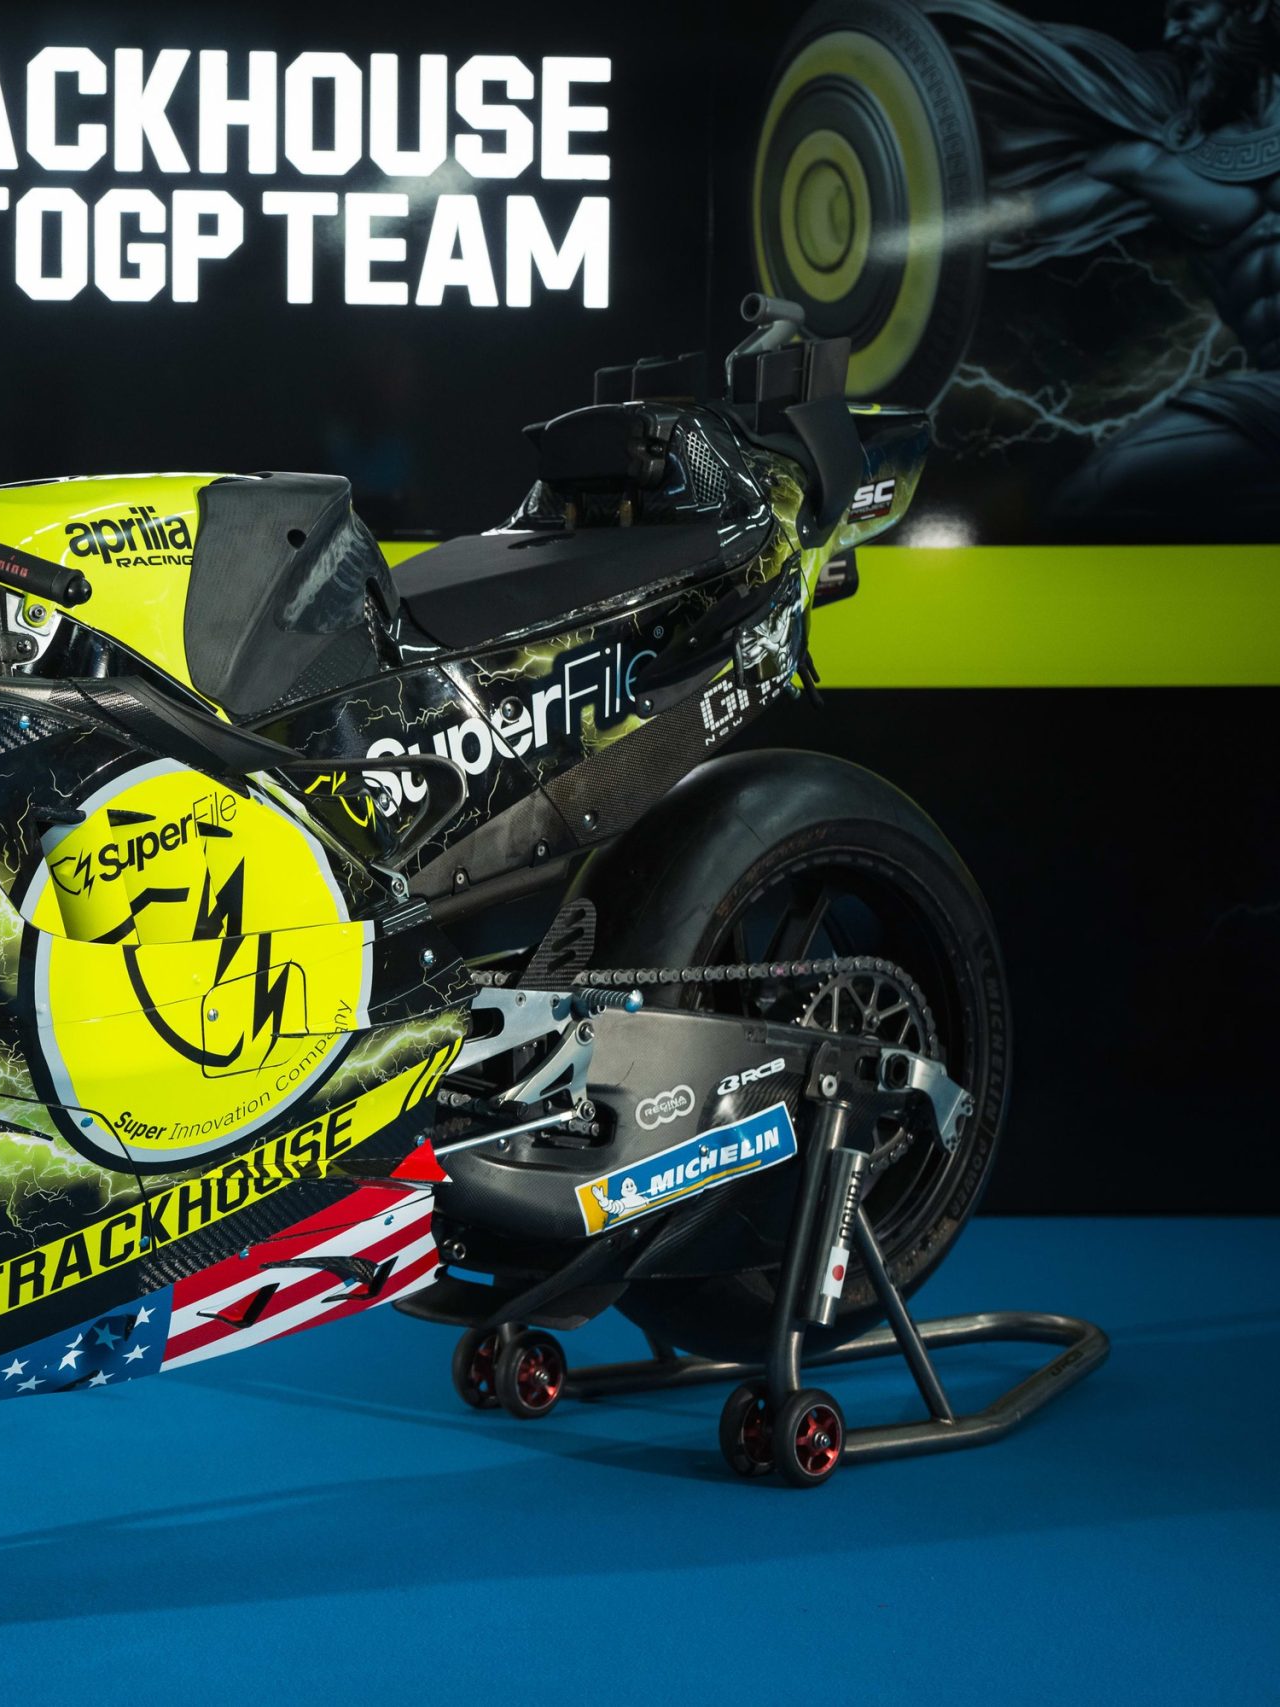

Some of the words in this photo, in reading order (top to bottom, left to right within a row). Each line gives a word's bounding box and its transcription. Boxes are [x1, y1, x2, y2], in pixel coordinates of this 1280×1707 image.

[262, 191, 610, 308] TEAM
[851, 479, 896, 510] SC
[65, 506, 192, 564] aprilia
[115, 555, 194, 568] RACING
[98, 791, 238, 882] SuperFile
[114, 1110, 168, 1141] Super
[168, 1090, 272, 1142] Innovation
[275, 999, 353, 1092] Company
[650, 1126, 780, 1195] MICHELIN
